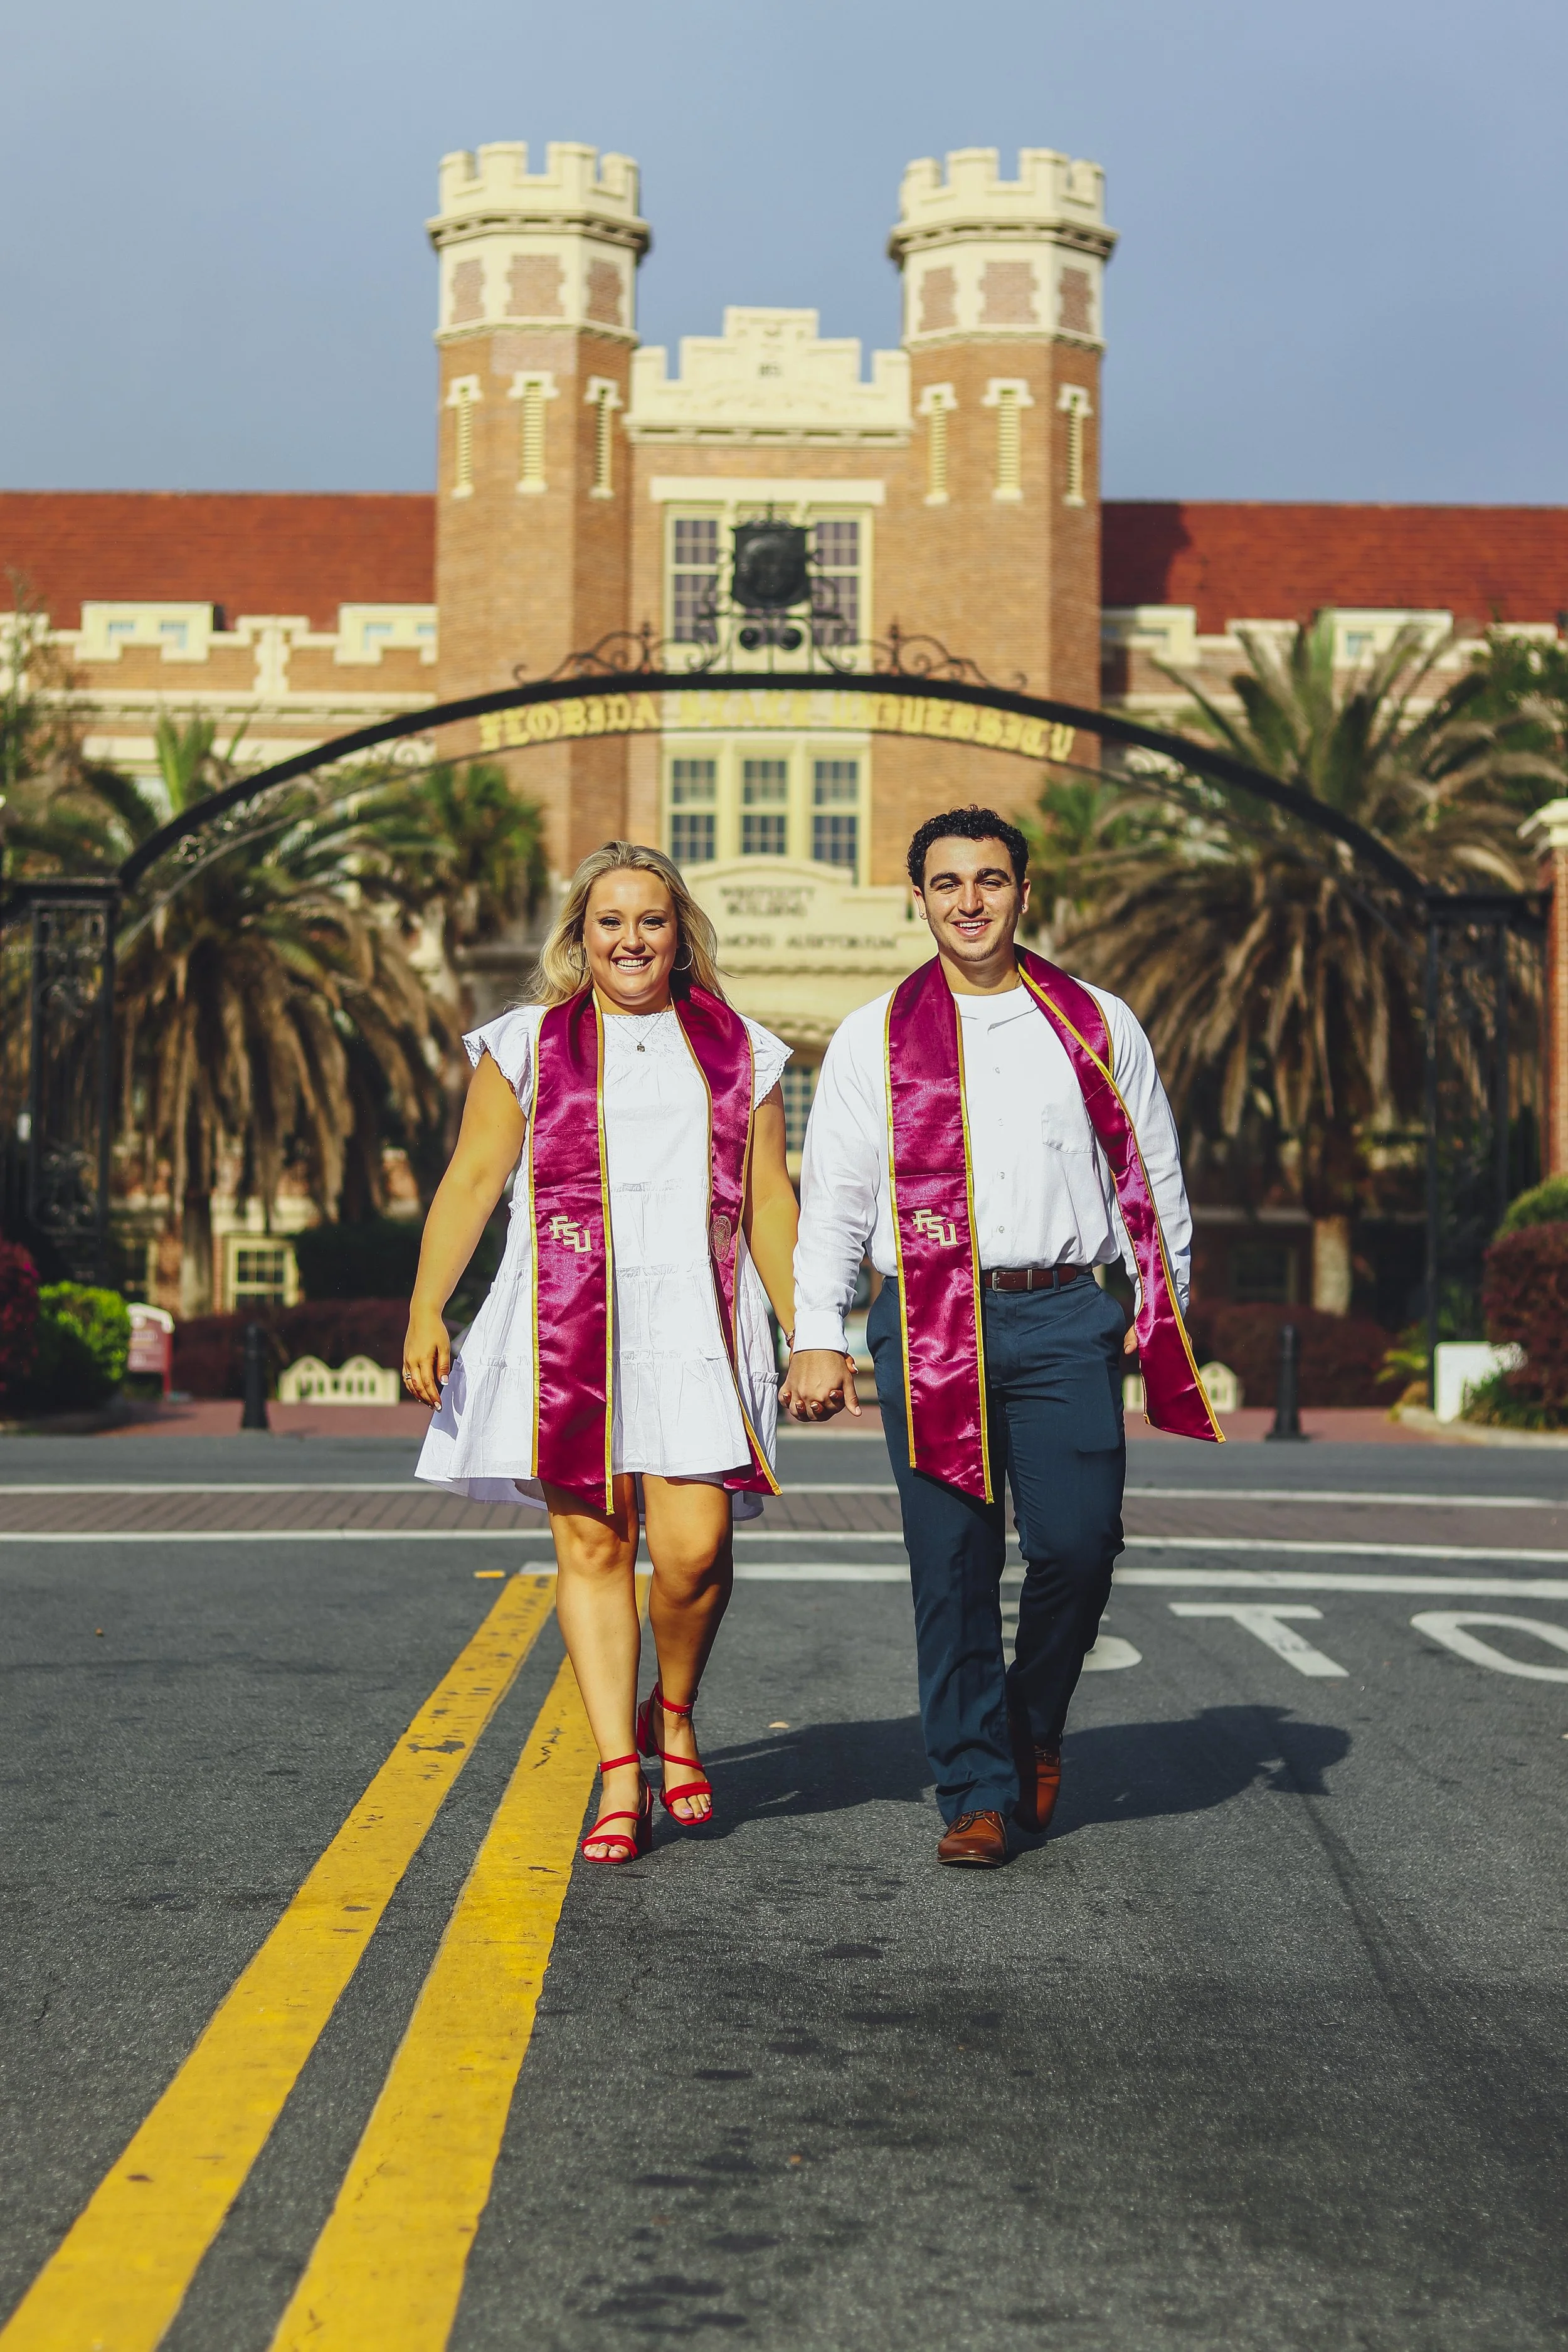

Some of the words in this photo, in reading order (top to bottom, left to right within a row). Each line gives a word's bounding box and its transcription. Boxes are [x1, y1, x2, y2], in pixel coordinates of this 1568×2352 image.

[479, 692, 659, 751] FLORIDA
[548, 1216, 593, 1253] FSU
[913, 1209, 959, 1246] FSU
